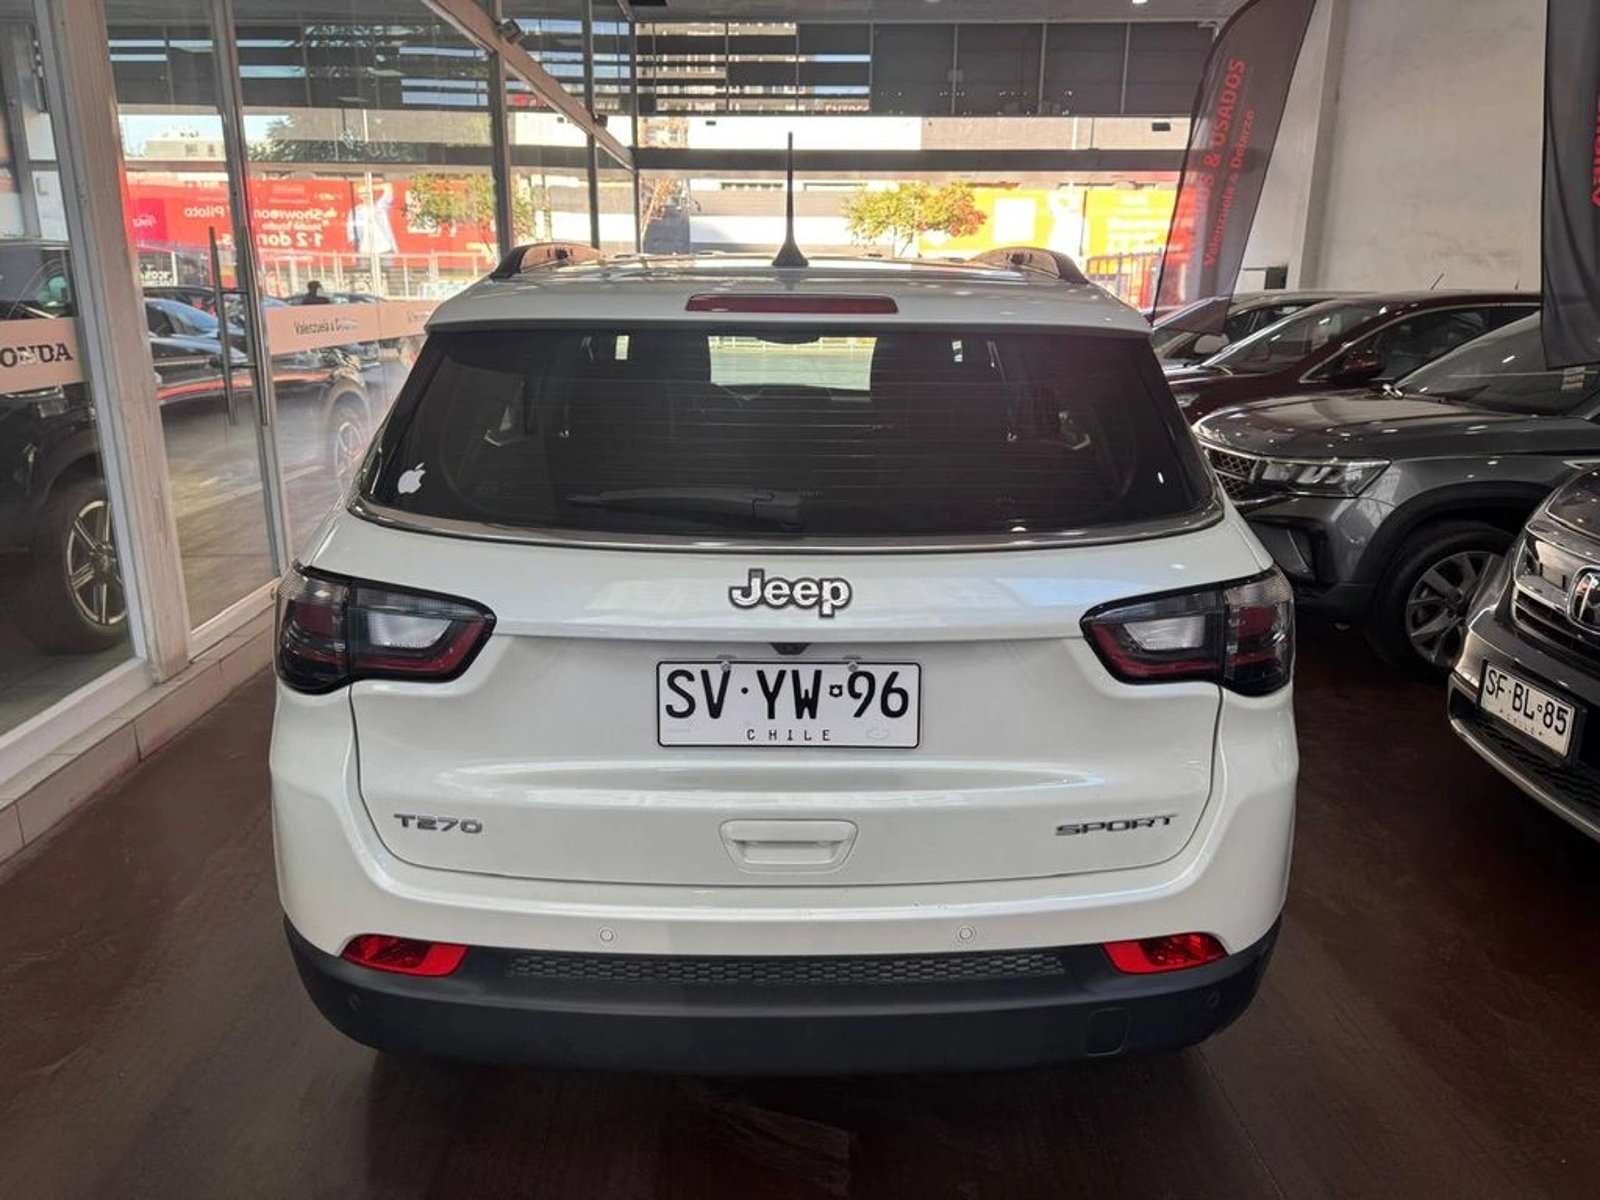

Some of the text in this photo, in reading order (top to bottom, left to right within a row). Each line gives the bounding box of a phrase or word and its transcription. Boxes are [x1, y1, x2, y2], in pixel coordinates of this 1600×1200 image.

[1213, 58, 1245, 147] USADOS
[729, 568, 852, 618] Jeep
[746, 728, 831, 742] CHILE
[393, 813, 482, 833] T270
[1055, 813, 1178, 836] SPORT
